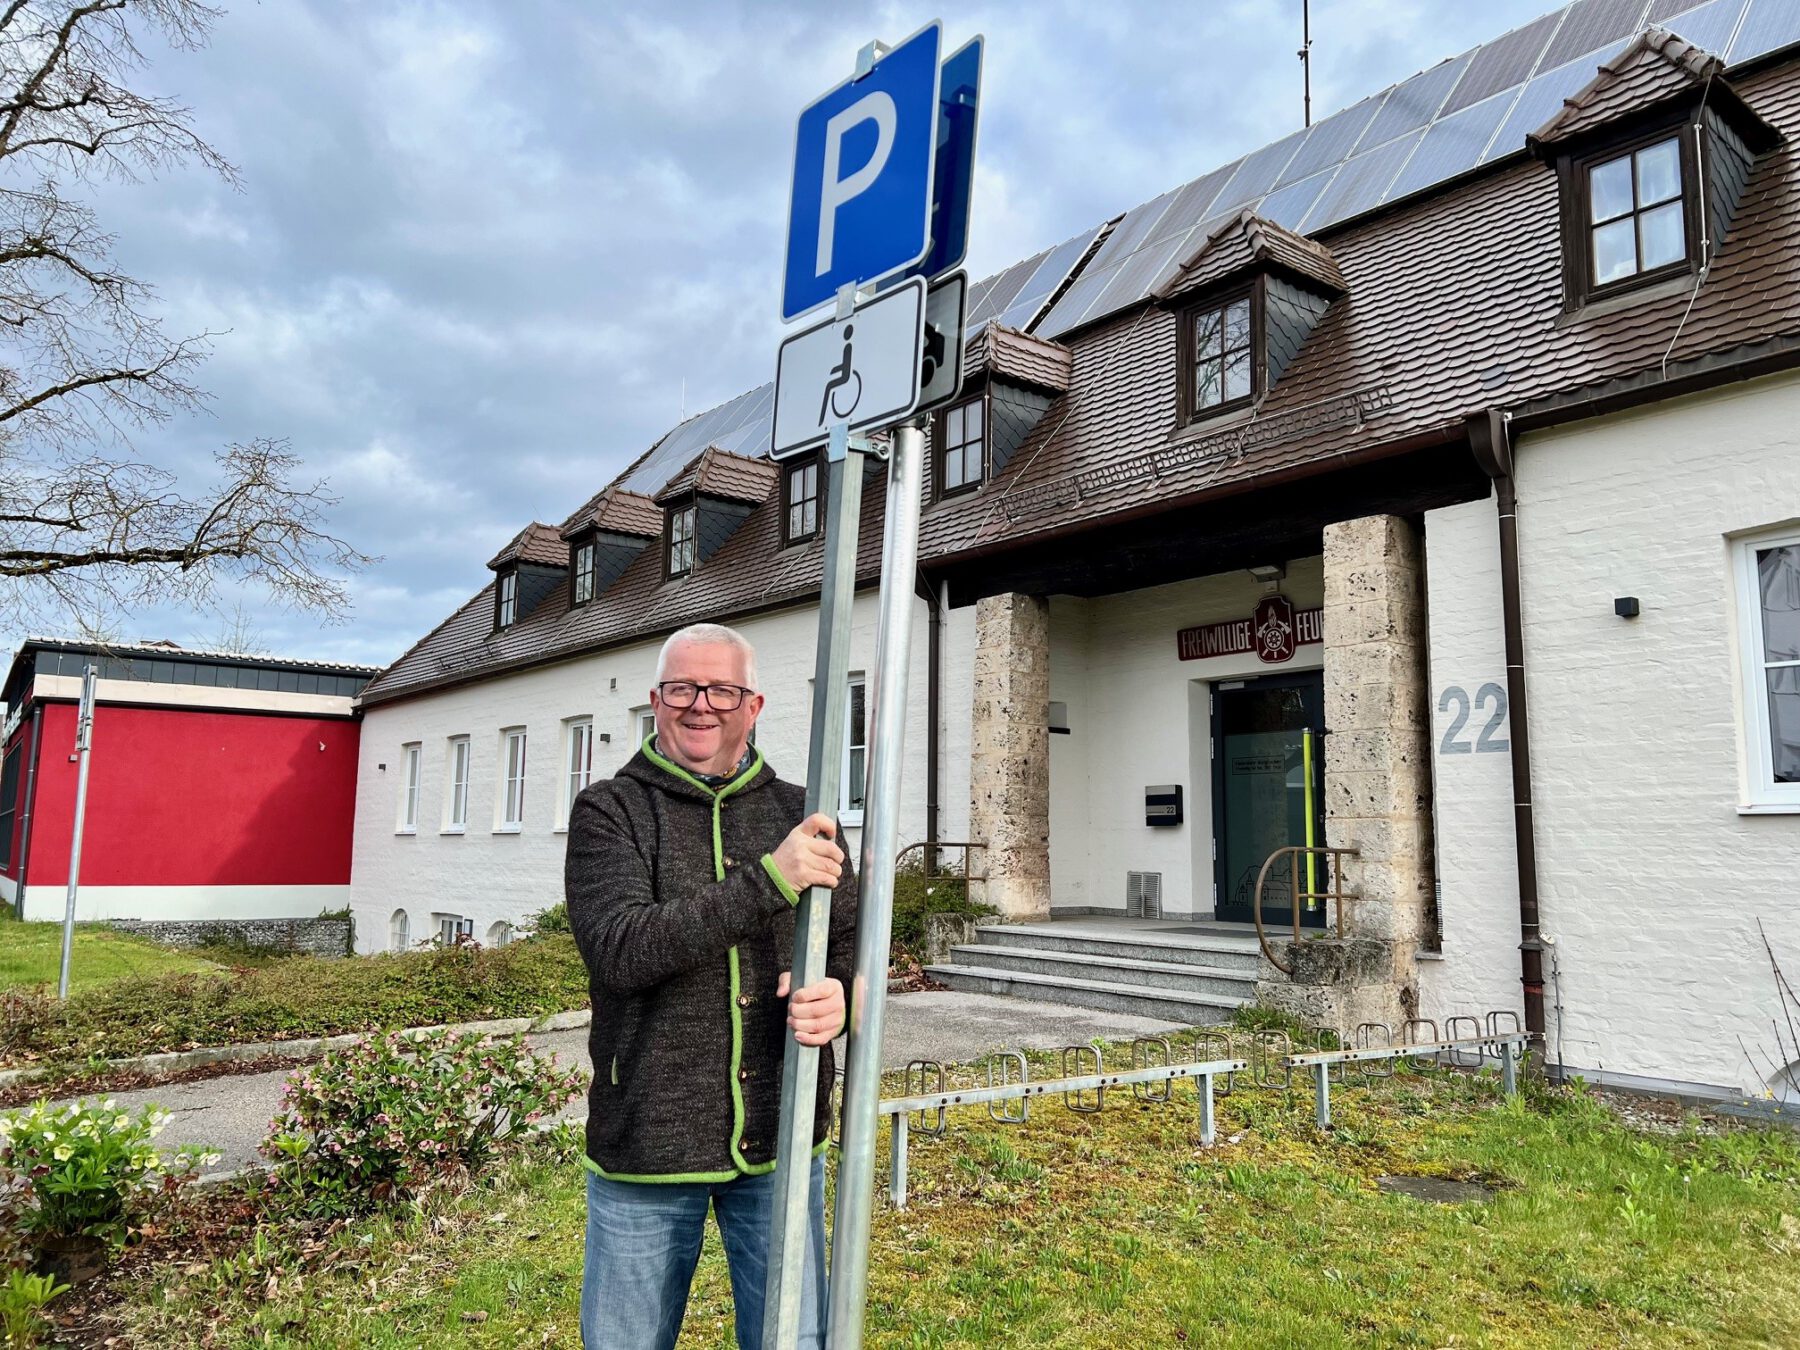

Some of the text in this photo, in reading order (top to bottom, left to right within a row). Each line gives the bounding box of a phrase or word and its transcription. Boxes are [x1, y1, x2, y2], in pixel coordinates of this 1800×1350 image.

[815, 90, 898, 279] P
[1181, 621, 1252, 658] FREIWILLIGE
[1438, 682, 1510, 755] 22
[1166, 806, 1175, 814] 22
